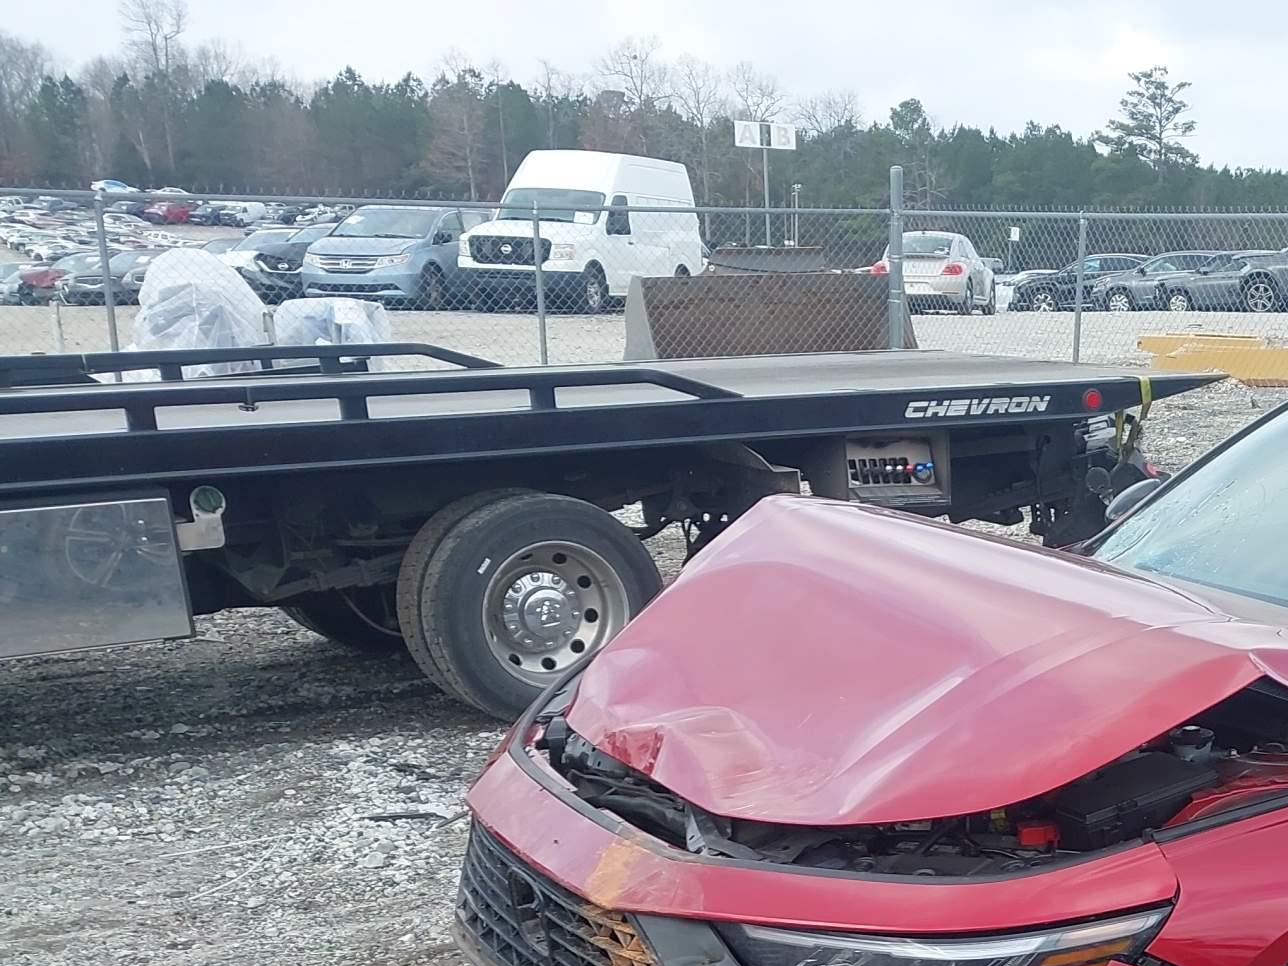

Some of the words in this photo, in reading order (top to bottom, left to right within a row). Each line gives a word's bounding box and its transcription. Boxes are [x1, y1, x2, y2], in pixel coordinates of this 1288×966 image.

[738, 124, 758, 145] A
[776, 126, 792, 146] B
[904, 395, 1052, 419] CHEVRON
